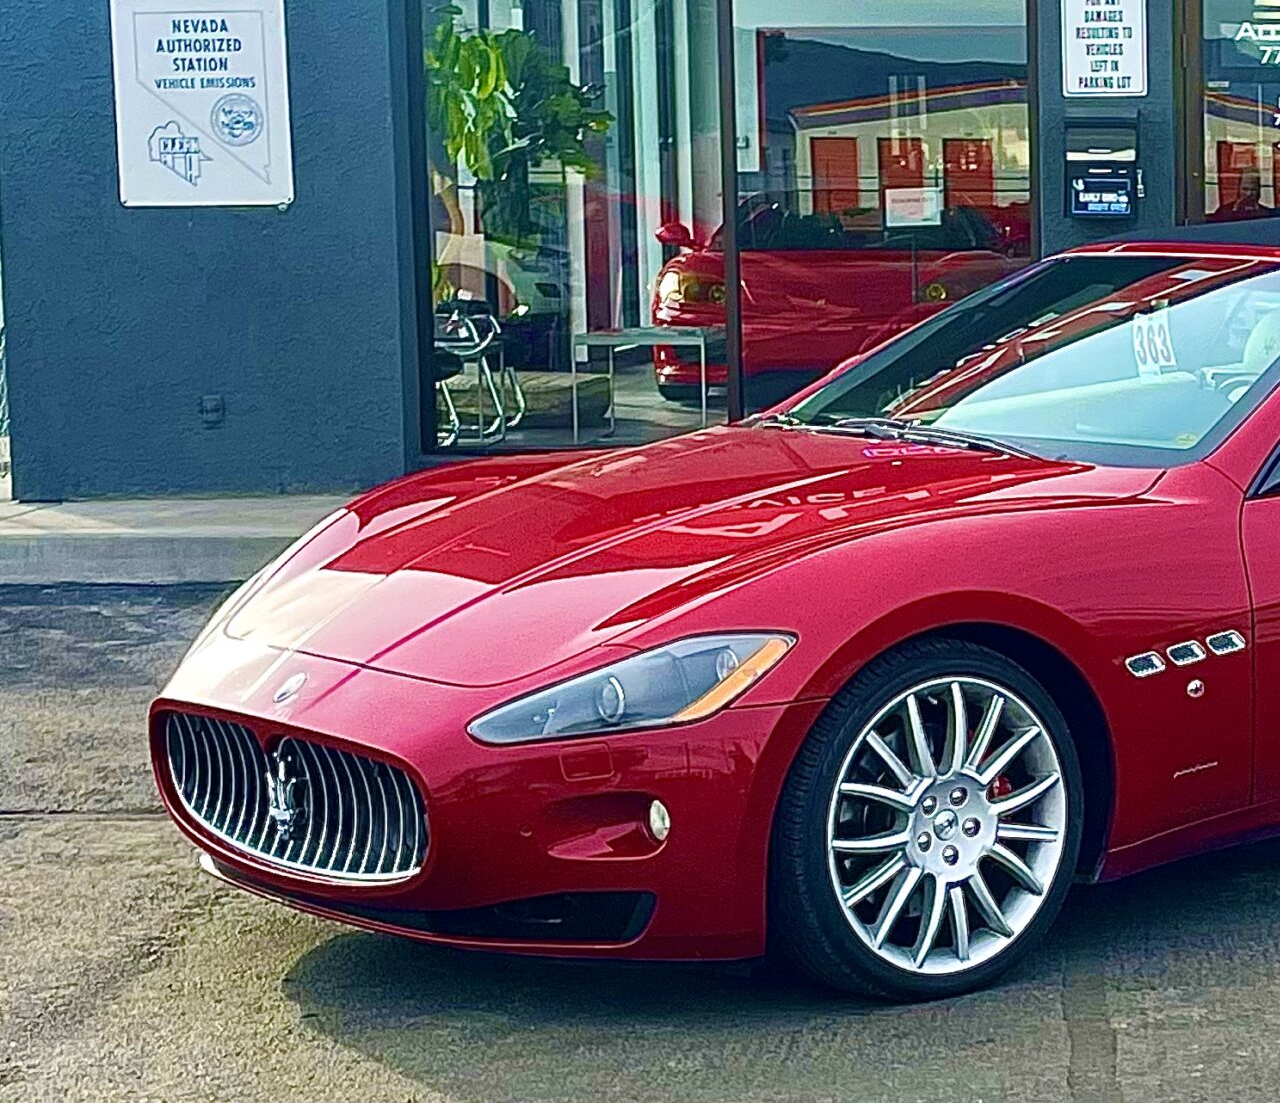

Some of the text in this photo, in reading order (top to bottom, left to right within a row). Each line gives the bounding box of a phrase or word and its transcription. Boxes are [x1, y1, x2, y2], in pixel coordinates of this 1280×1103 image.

[1084, 10, 1123, 22] DAMAGES
[172, 19, 229, 34] NEVADA
[1076, 27, 1132, 39] RESULTING TO
[156, 38, 242, 53] AUTHORIZED
[1085, 44, 1123, 55] VEHICLES
[172, 57, 229, 72] STATION
[1090, 60, 1119, 72] LEFT IN
[154, 76, 256, 89] VEHICLE EMISSIONS
[1078, 76, 1131, 88] PARKING LOT
[1135, 323, 1172, 365] 363
